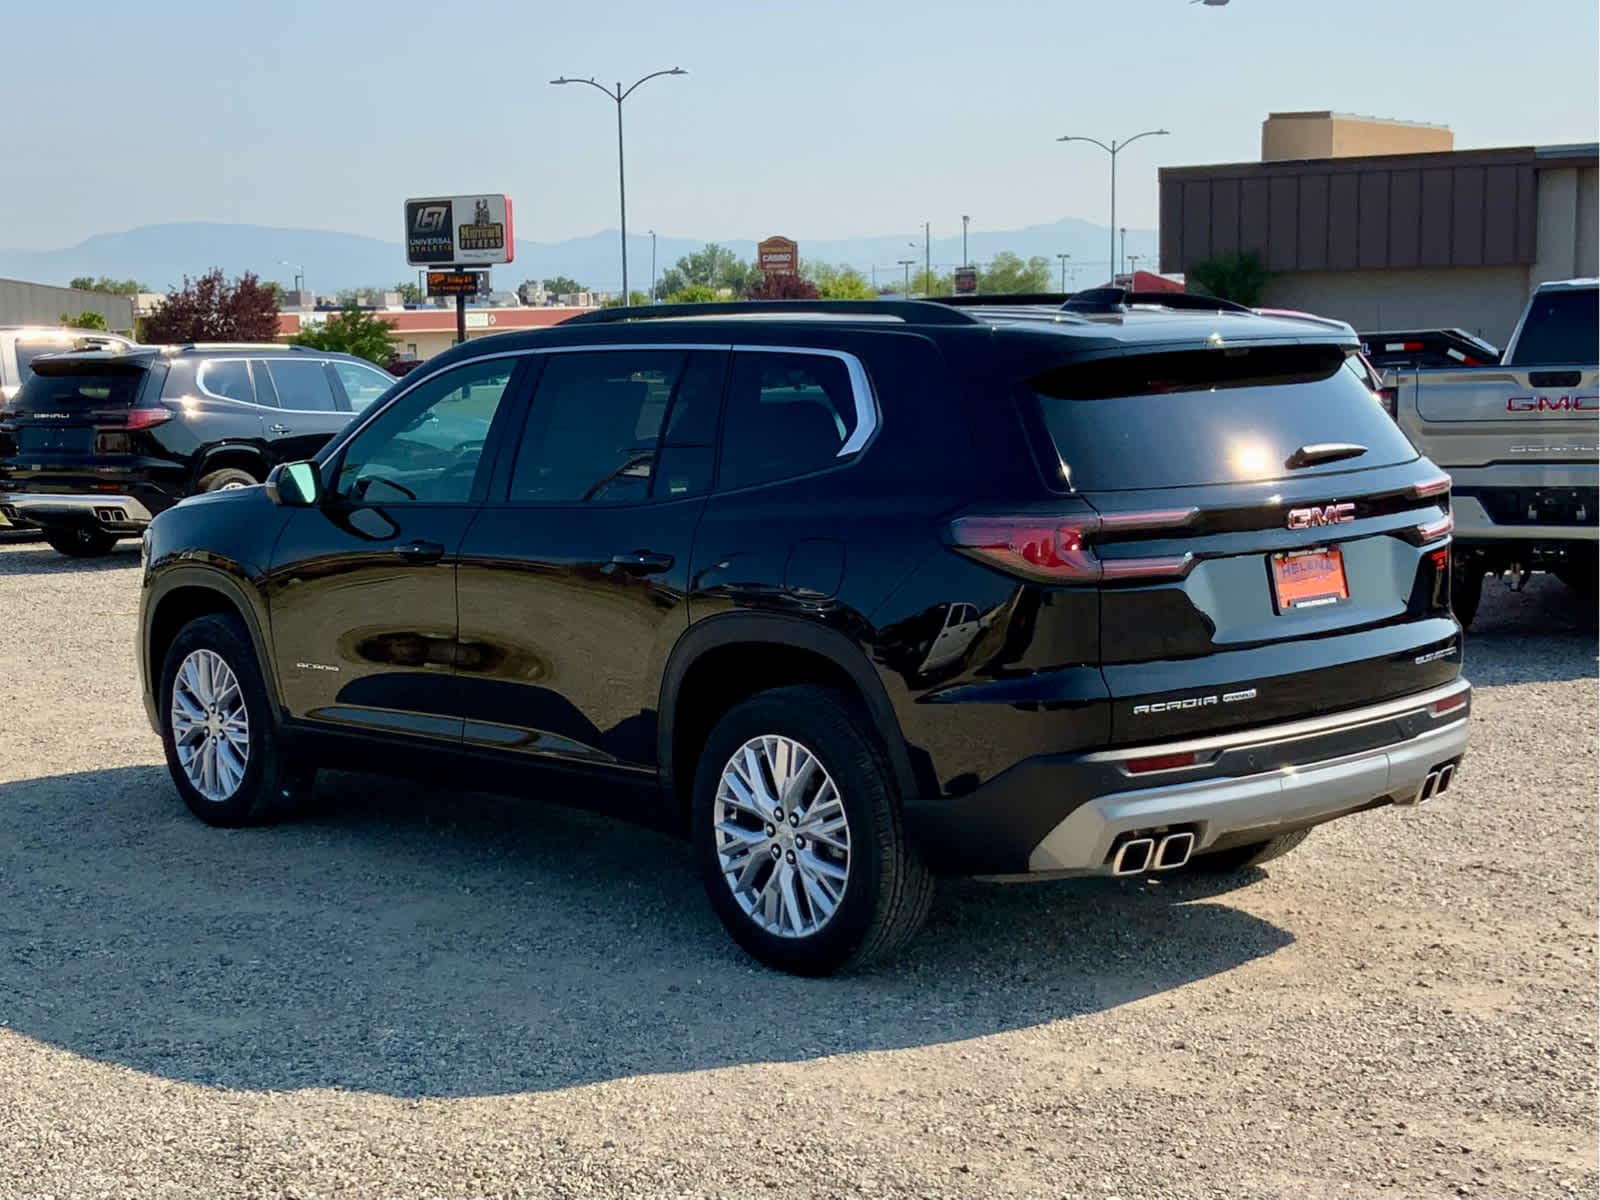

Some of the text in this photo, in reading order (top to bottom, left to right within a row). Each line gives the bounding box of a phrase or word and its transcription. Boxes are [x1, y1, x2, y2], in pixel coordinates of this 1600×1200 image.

[409, 238, 452, 246] UNIVERSAL
[1506, 396, 1600, 412] GMC
[1288, 503, 1355, 530] GMC
[1133, 696, 1218, 714] ACADIA
